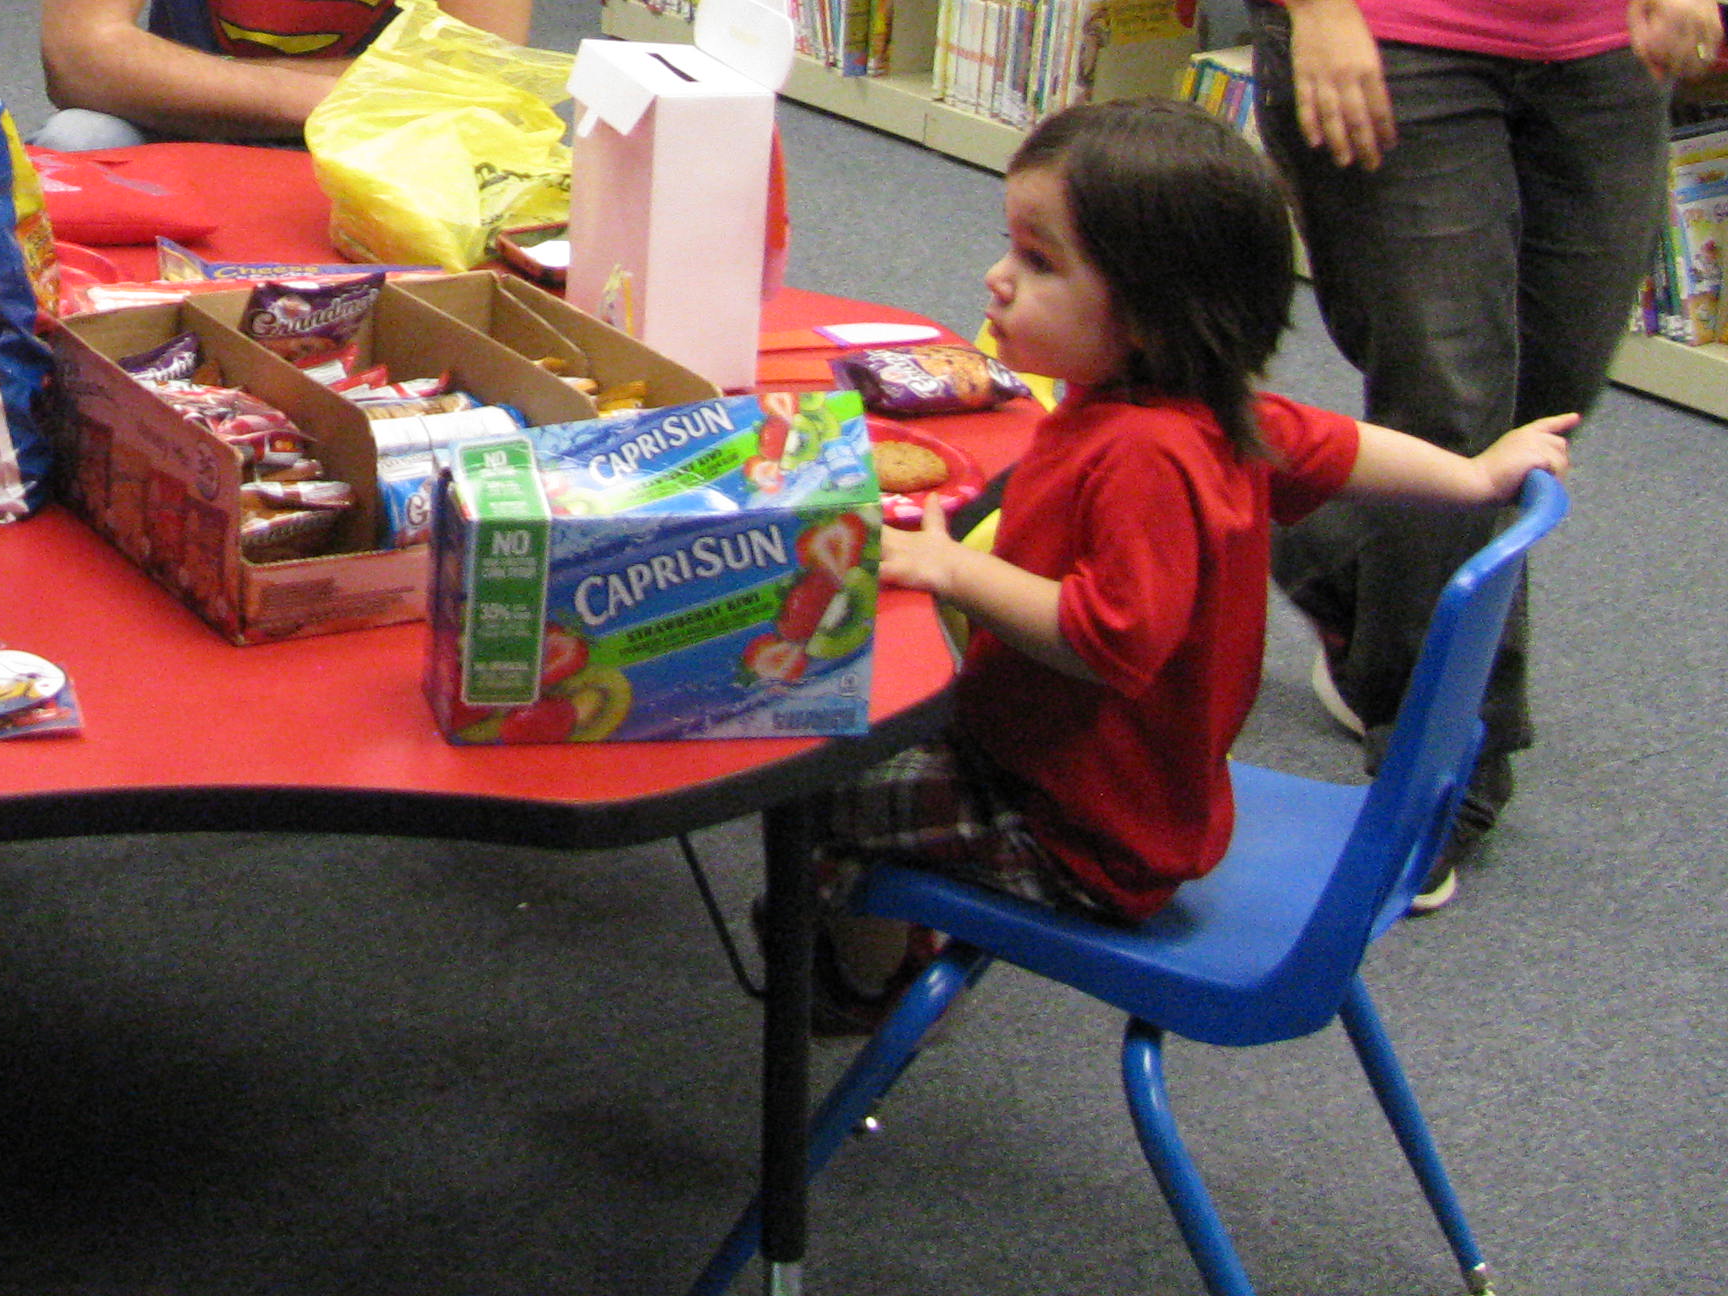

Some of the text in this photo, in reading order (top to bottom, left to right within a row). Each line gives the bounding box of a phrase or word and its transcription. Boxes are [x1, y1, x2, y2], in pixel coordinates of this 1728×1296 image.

[214, 263, 320, 280] Cheese
[482, 450, 508, 467] NO
[492, 530, 531, 555] NO
